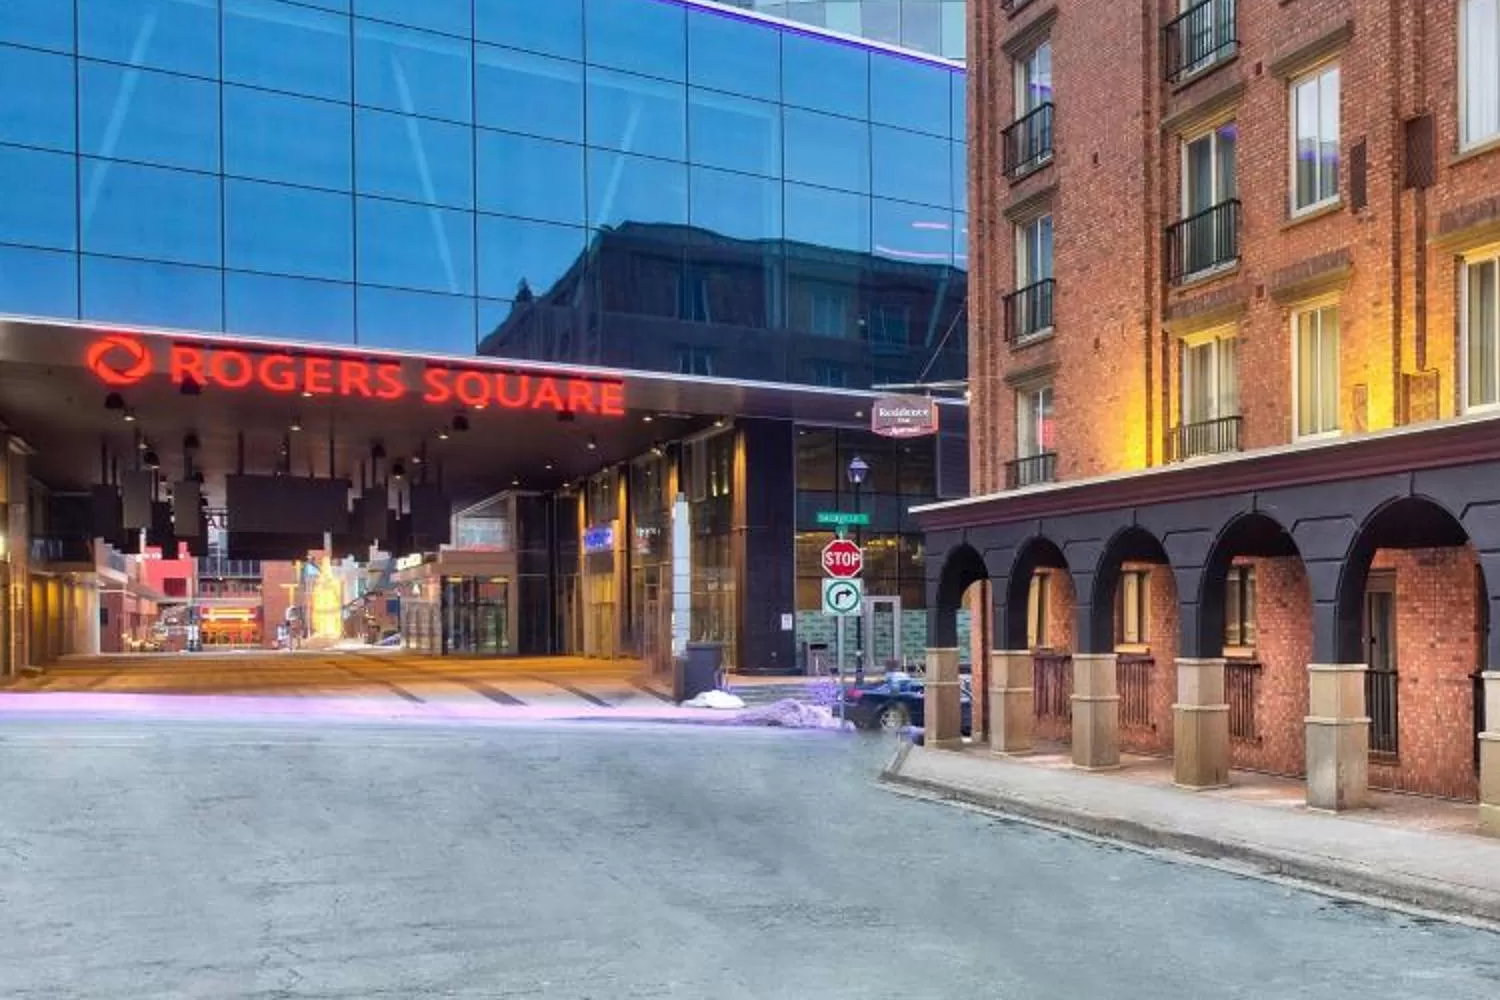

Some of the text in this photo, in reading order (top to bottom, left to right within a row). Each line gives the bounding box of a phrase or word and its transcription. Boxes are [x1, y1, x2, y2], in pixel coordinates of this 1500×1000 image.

[170, 345, 625, 416] ROGERS SQUARE
[825, 551, 860, 567] STOP
